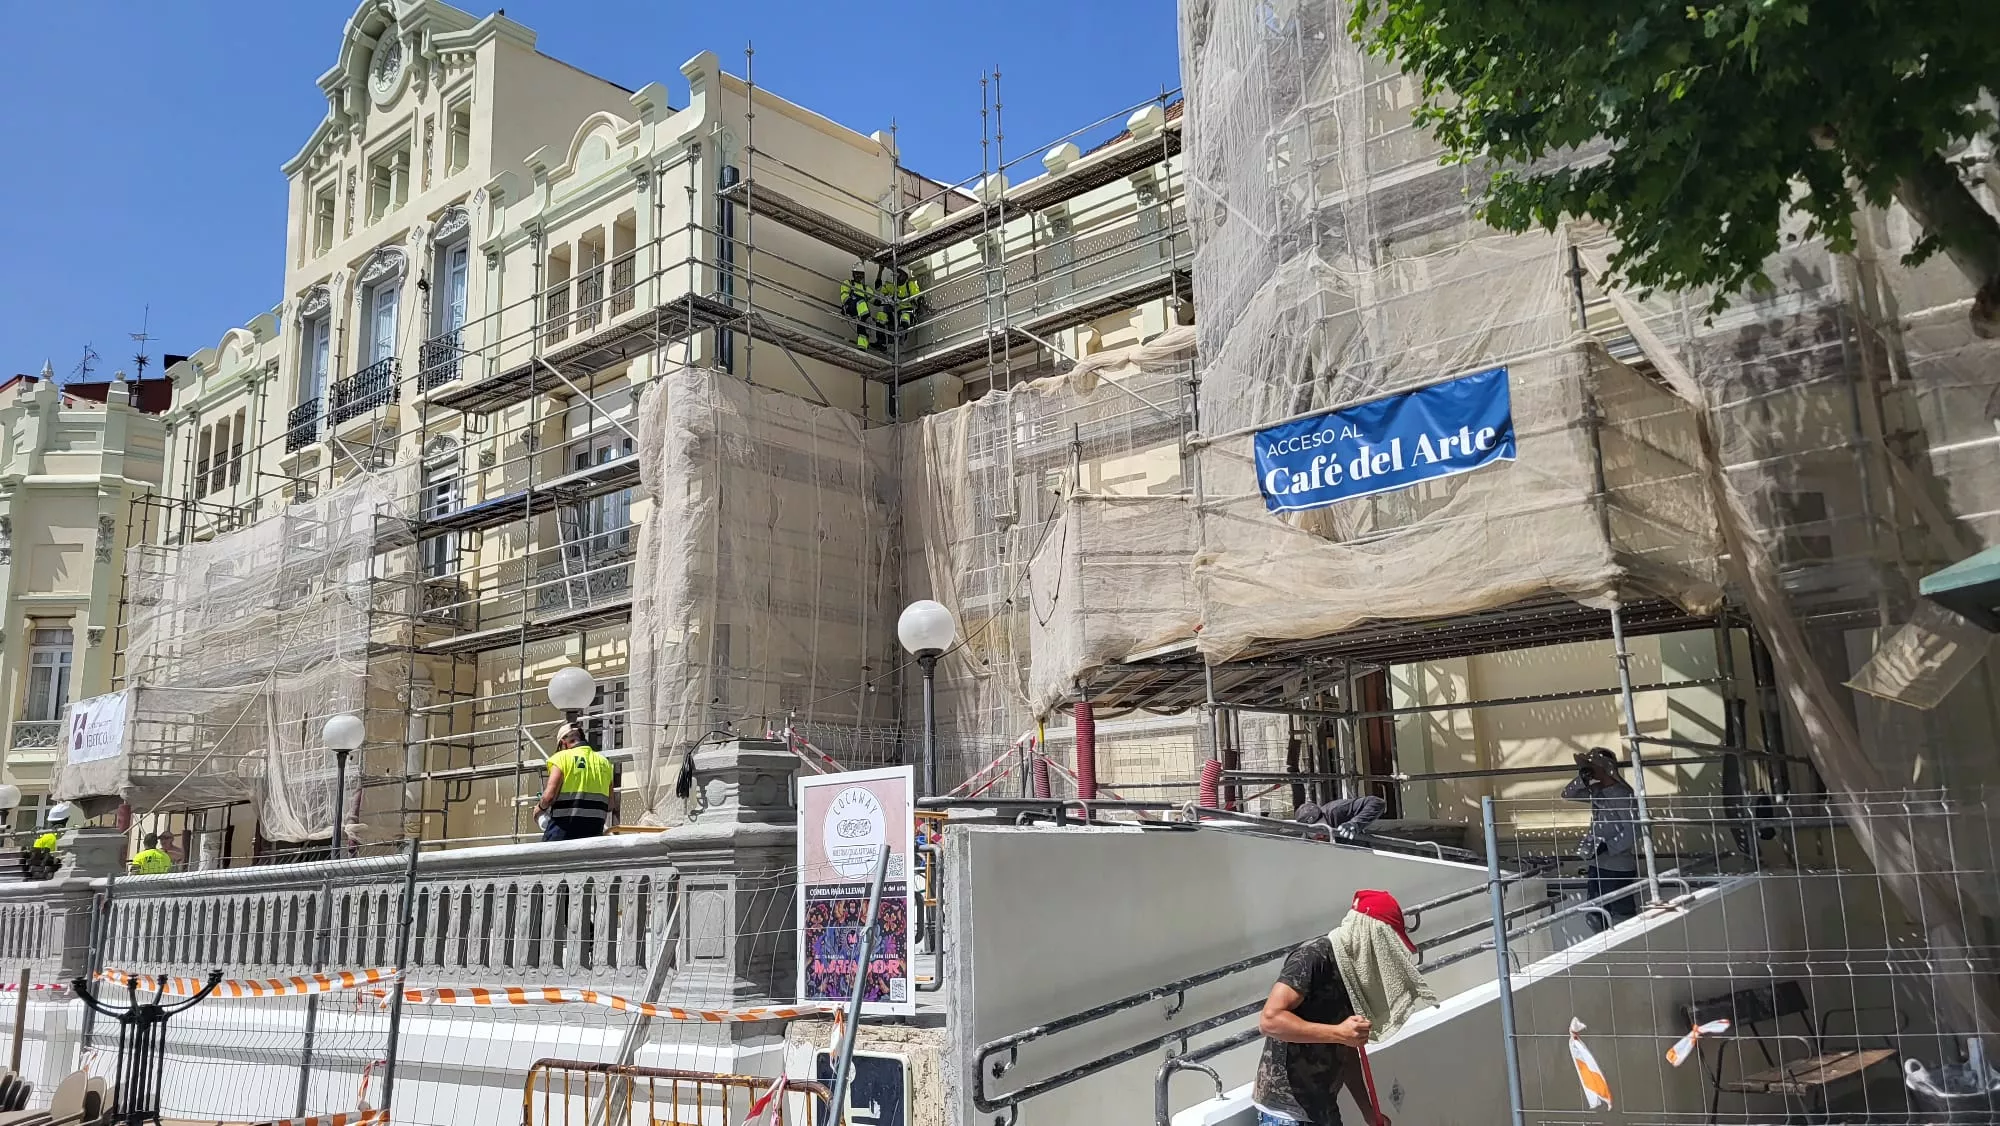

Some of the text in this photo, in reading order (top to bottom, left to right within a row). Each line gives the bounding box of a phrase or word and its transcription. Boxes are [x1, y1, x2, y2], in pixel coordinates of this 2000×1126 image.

[1266, 423, 1364, 458] ACCESO AL
[1265, 424, 1497, 495] Café del Arte
[830, 887, 845, 896] PARA
[814, 959, 901, 974] MATAOR
